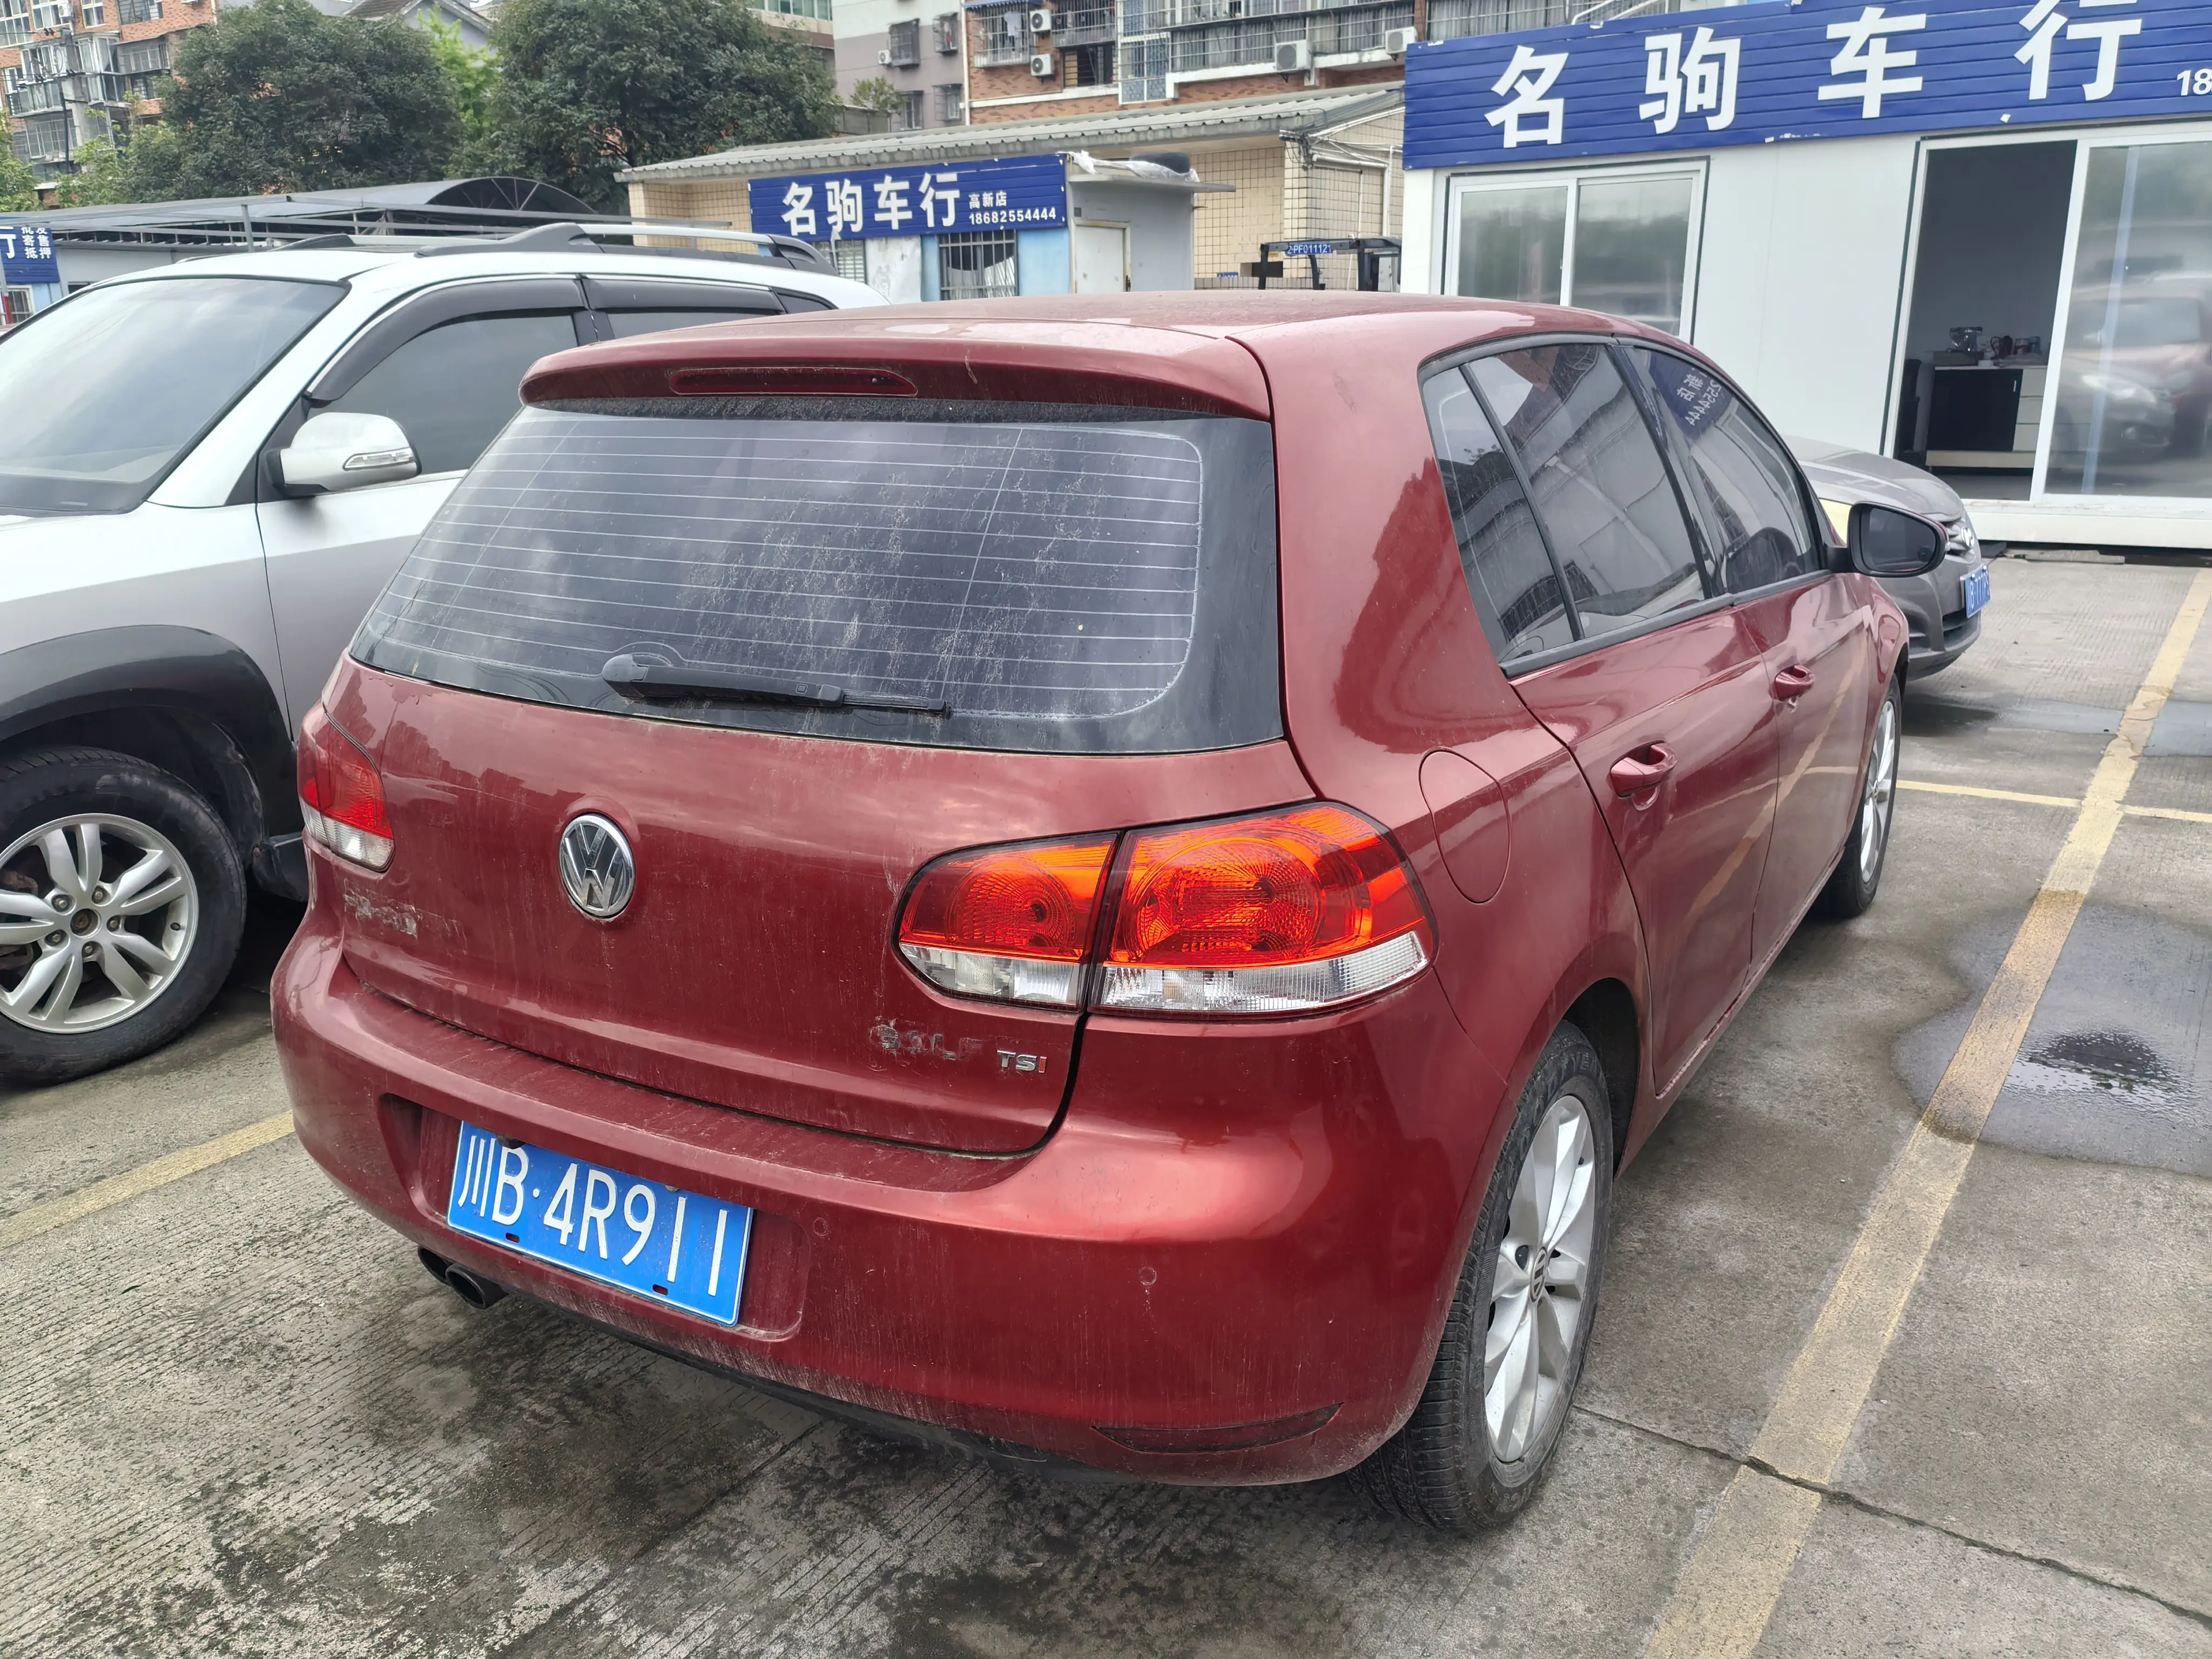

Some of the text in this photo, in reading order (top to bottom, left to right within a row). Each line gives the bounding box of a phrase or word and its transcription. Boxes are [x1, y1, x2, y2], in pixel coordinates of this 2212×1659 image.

[1484, 0, 2142, 148] 名驹车行
[781, 172, 960, 236] 名驹车行
[968, 191, 1007, 209] 高新店
[969, 207, 1056, 225] 18682554444
[997, 1049, 1047, 1073] TSI
[458, 1135, 727, 1296] 川B·4R911
